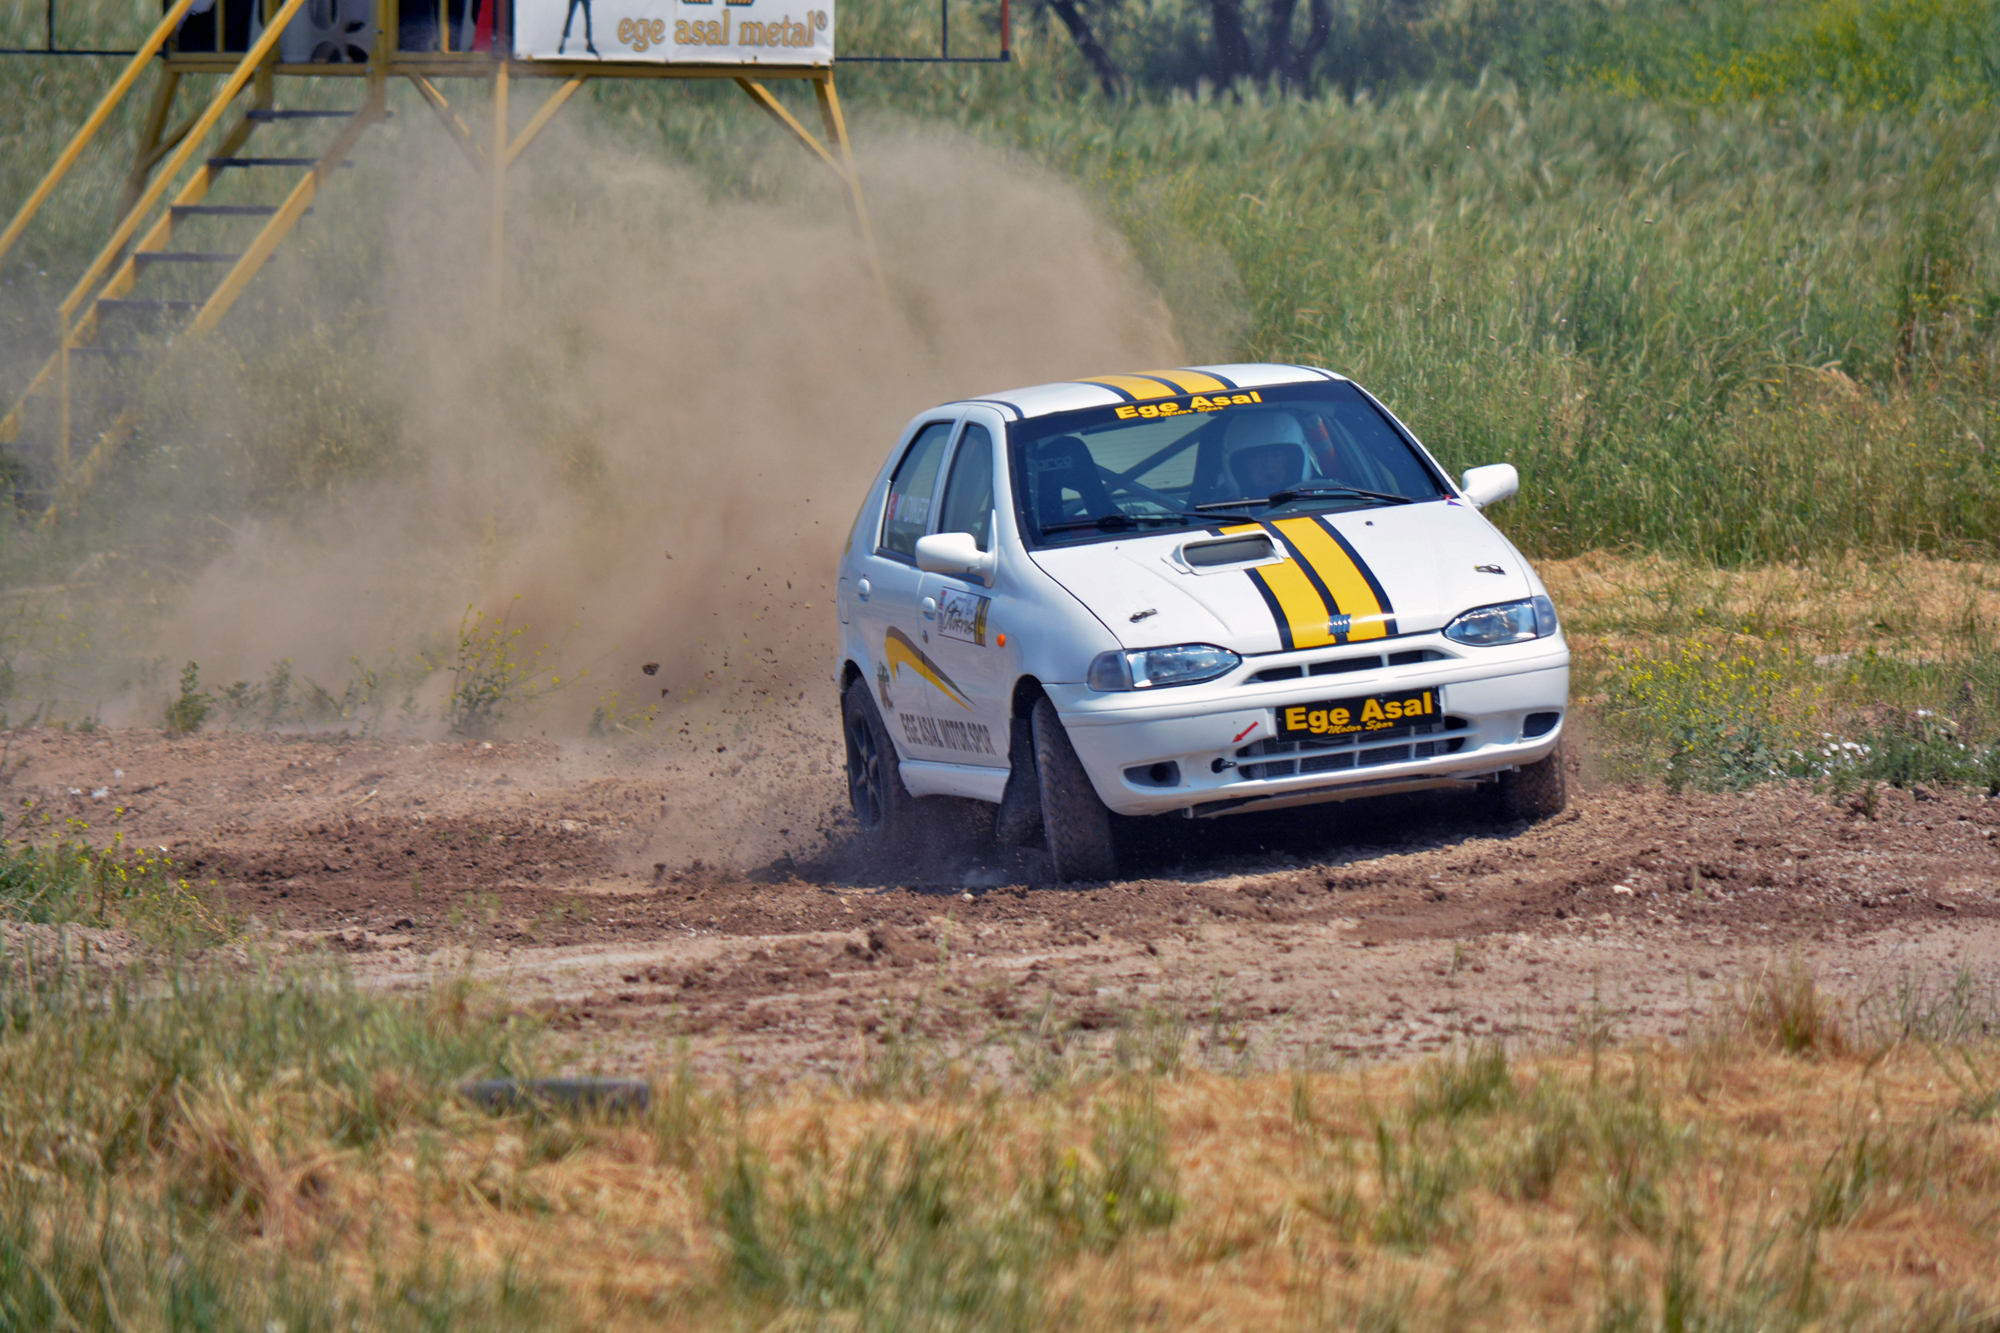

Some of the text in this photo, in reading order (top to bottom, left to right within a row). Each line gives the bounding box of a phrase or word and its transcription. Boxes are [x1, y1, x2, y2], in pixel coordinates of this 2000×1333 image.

[617, 17, 665, 52] ege
[674, 9, 731, 46] asal
[1115, 391, 1262, 419] Ege Asal
[1285, 692, 1433, 733] Ege Asal
[1326, 719, 1395, 735] Motor Spor
[900, 713, 997, 756] EGE ASAL MOTOR SPOR
